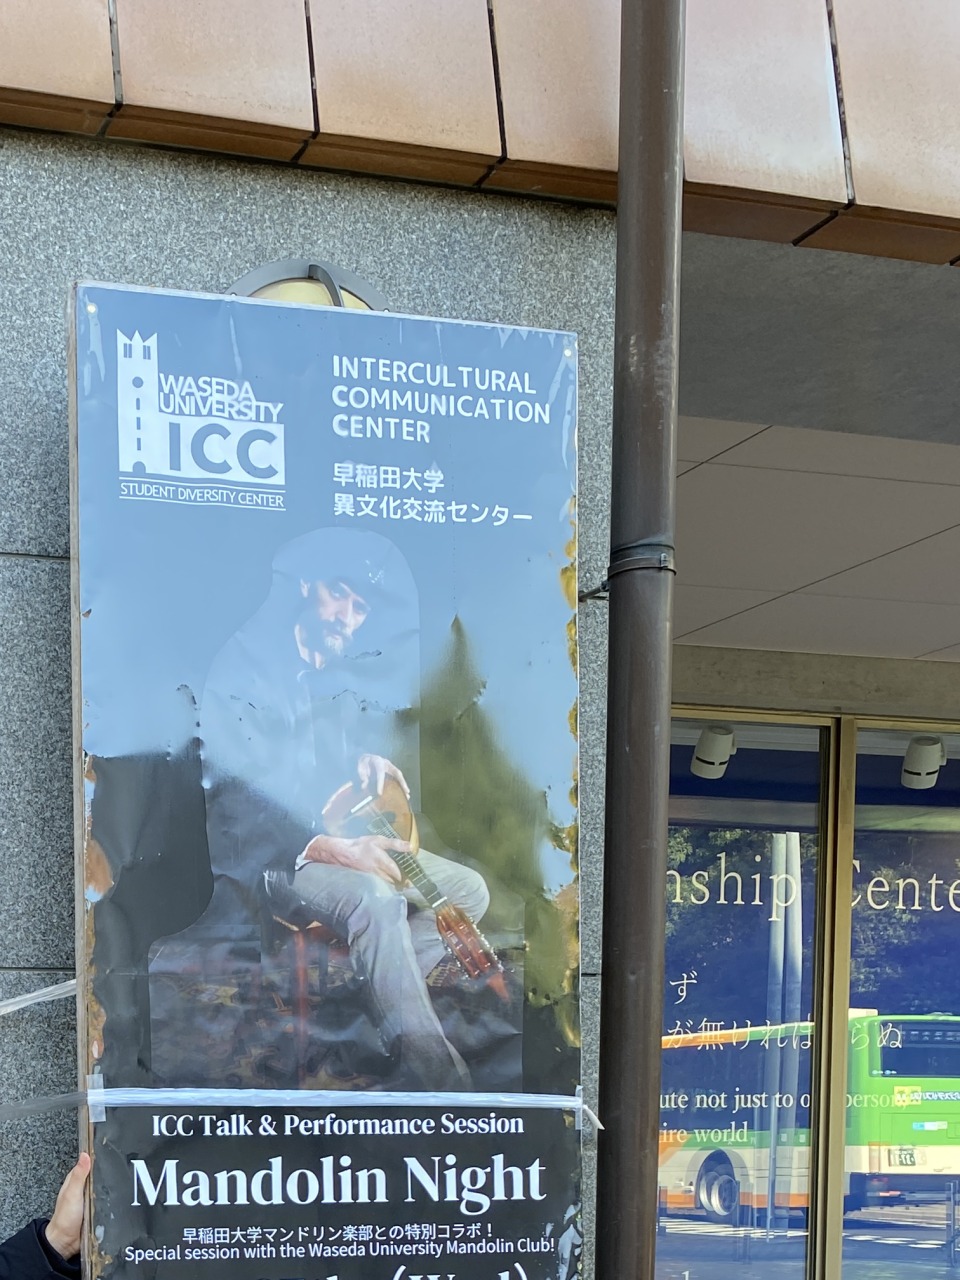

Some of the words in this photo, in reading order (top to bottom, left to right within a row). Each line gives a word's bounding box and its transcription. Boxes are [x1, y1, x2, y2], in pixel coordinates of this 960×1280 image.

[159, 373, 257, 402] WASEDA
[333, 355, 537, 394] INTERCULTURAL
[159, 391, 284, 422] UNIVERSITY
[332, 385, 551, 425] COMMUNICATION
[332, 414, 430, 443] CENTER
[168, 421, 279, 479] ICC
[333, 462, 445, 492] 早稲田大学
[120, 482, 176, 499] STUDENT
[178, 488, 236, 504] DIVERSITY
[238, 492, 284, 508] CENTER
[334, 493, 533, 526] 異文化交流センター
[695, 1091, 728, 1109] not
[732, 1087, 768, 1114] just
[775, 1091, 794, 1109] to
[152, 1115, 194, 1137] ICC
[199, 1113, 253, 1137] Talk
[259, 1115, 278, 1136] &
[284, 1112, 435, 1136] Performance
[441, 1112, 525, 1134] Session
[659, 1121, 688, 1143] ire
[130, 1155, 389, 1208] Mandolin
[403, 1153, 547, 1216] Night
[125, 1245, 181, 1263] Special
[184, 1244, 240, 1260] session
[243, 1243, 277, 1259] with
[280, 1243, 305, 1259] the
[308, 1242, 366, 1258] Waseda
[369, 1240, 444, 1259] University
[446, 1238, 514, 1256] Mandolin
[517, 1237, 555, 1254] Club!
